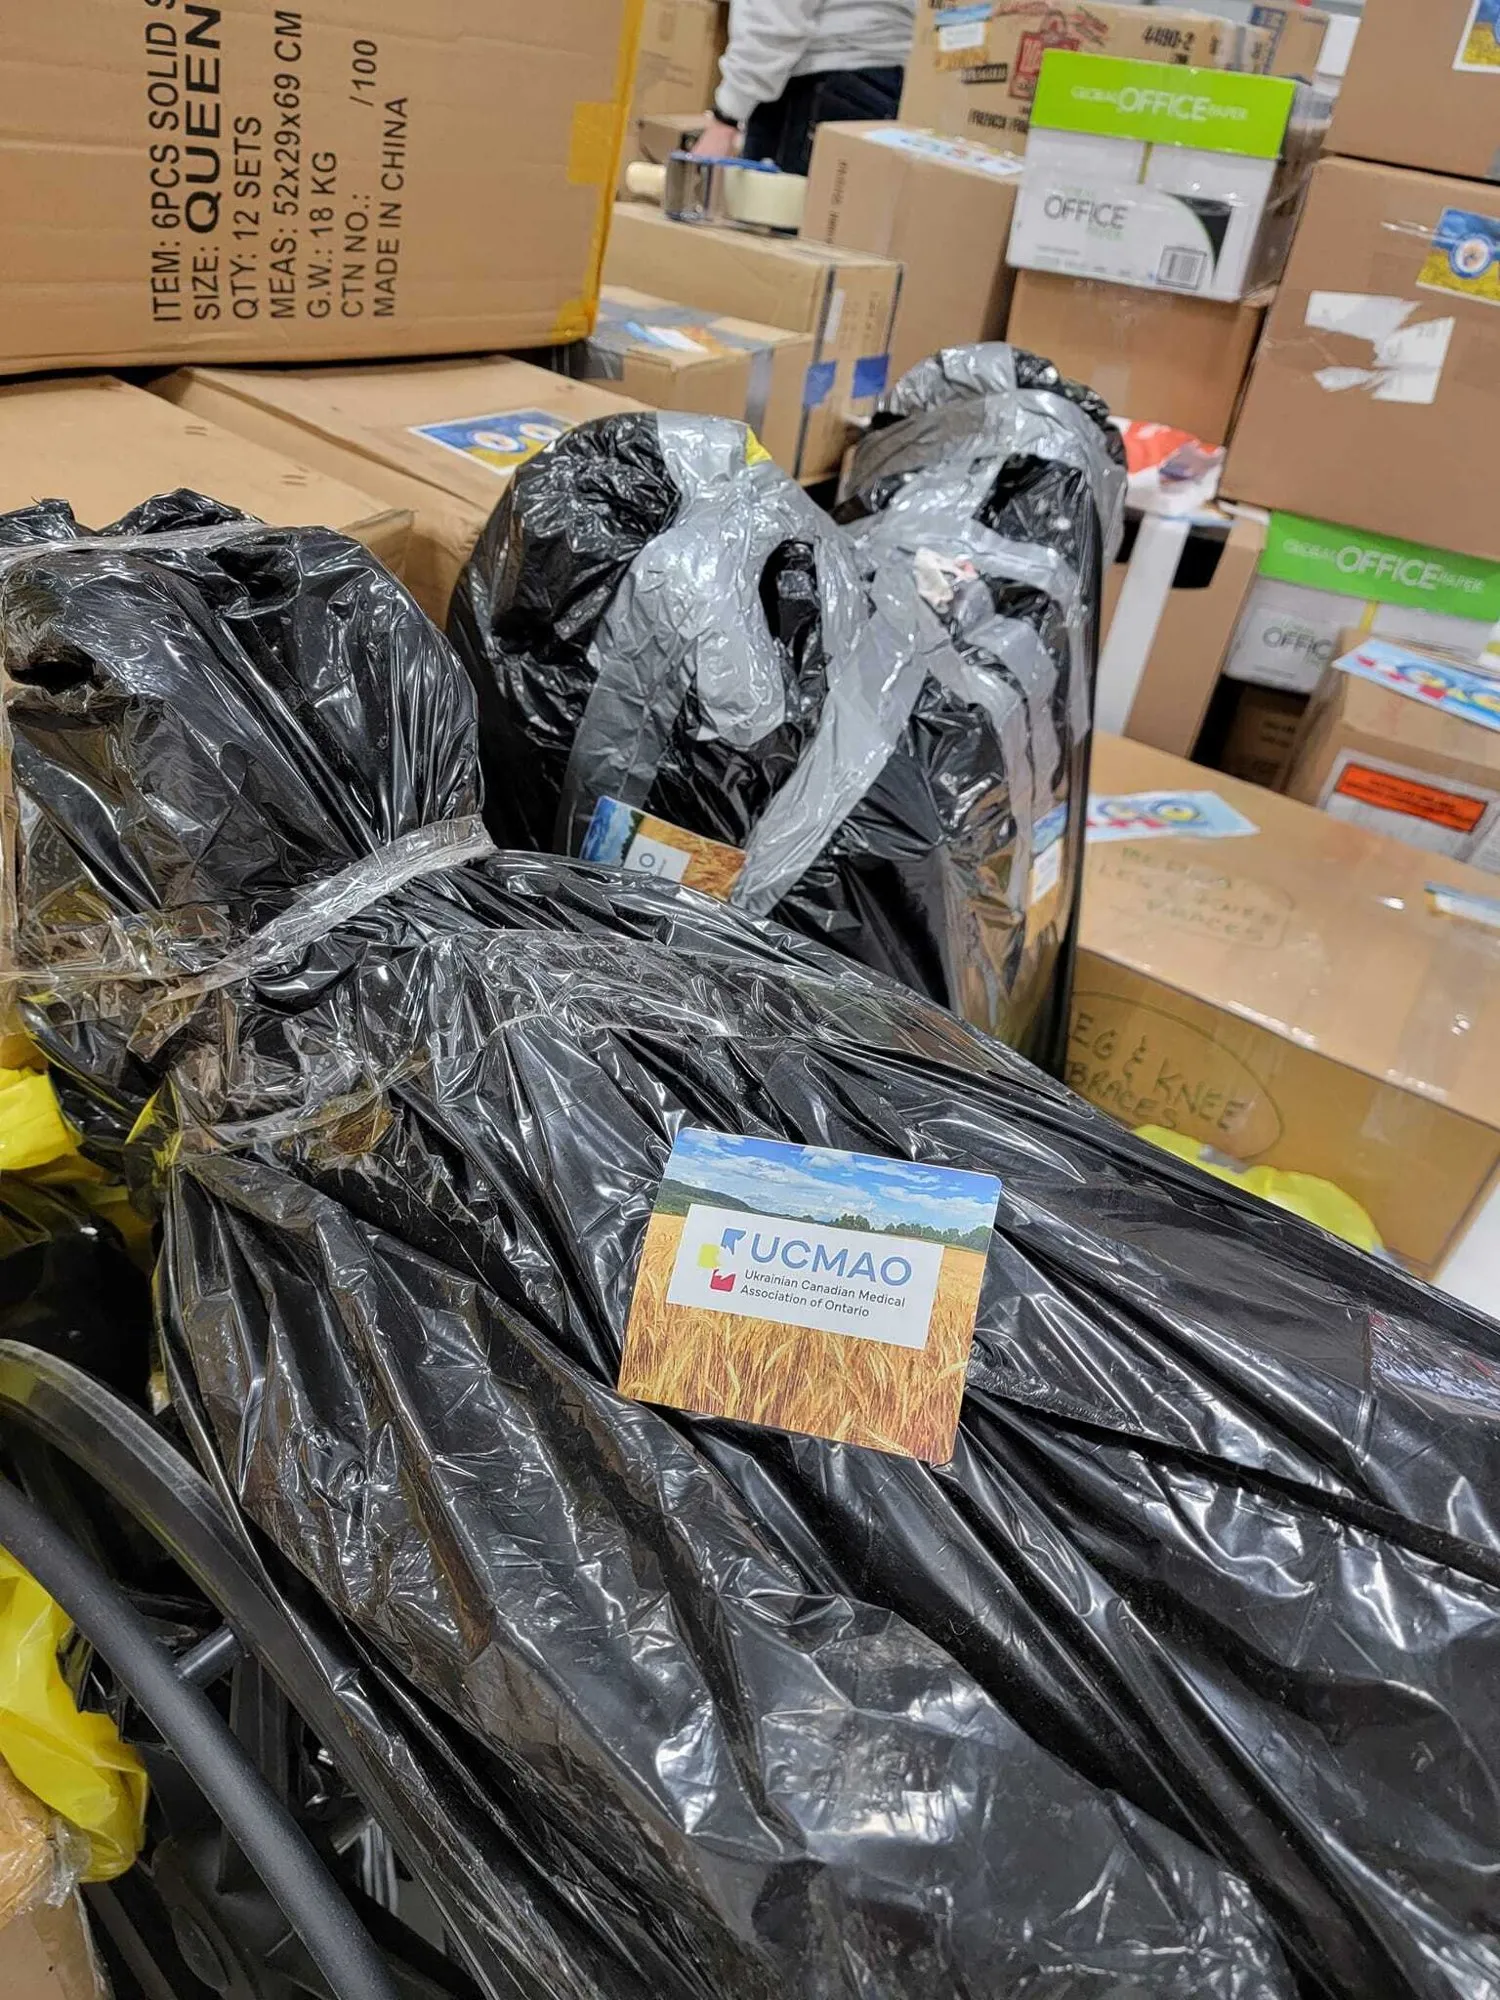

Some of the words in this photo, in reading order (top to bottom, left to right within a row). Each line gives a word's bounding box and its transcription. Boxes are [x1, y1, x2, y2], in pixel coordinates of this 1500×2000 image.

[274, 10, 302, 62] CM
[145, 22, 179, 130] SOLID
[349, 40, 378, 107] /100
[1116, 87, 1211, 121] OFFICE
[184, 4, 222, 233] QUEEN
[273, 73, 301, 216] 52x29x69
[381, 97, 408, 191] CHINA
[150, 144, 180, 229] 6PCS
[234, 116, 262, 198] SETS
[312, 152, 336, 195] KG
[232, 210, 259, 240] 12
[309, 207, 333, 237] 18
[344, 194, 370, 252] NO.:
[379, 202, 402, 228] IN
[1043, 194, 1129, 230] OFFICE
[151, 241, 181, 322] ITEM:
[193, 247, 220, 320] SIZE:
[229, 254, 259, 319] QTY:
[269, 228, 298, 319] MEAS:
[307, 249, 332, 319] G.W.:
[341, 263, 365, 317] CTN
[373, 238, 399, 317] MADE
[1335, 546, 1441, 590] OFFICE
[1263, 627, 1332, 660] OFFIC
[1068, 1060, 1178, 1129] BRACES
[1152, 1058, 1249, 1131] KNEE
[745, 1269, 798, 1288] Ukrainian
[801, 1280, 855, 1299] Canadian
[858, 1290, 906, 1308] Medical
[750, 1233, 912, 1286] UCMAO
[740, 1285, 807, 1305] Association
[810, 1298, 823, 1308] of
[825, 1301, 869, 1317] Ontario
